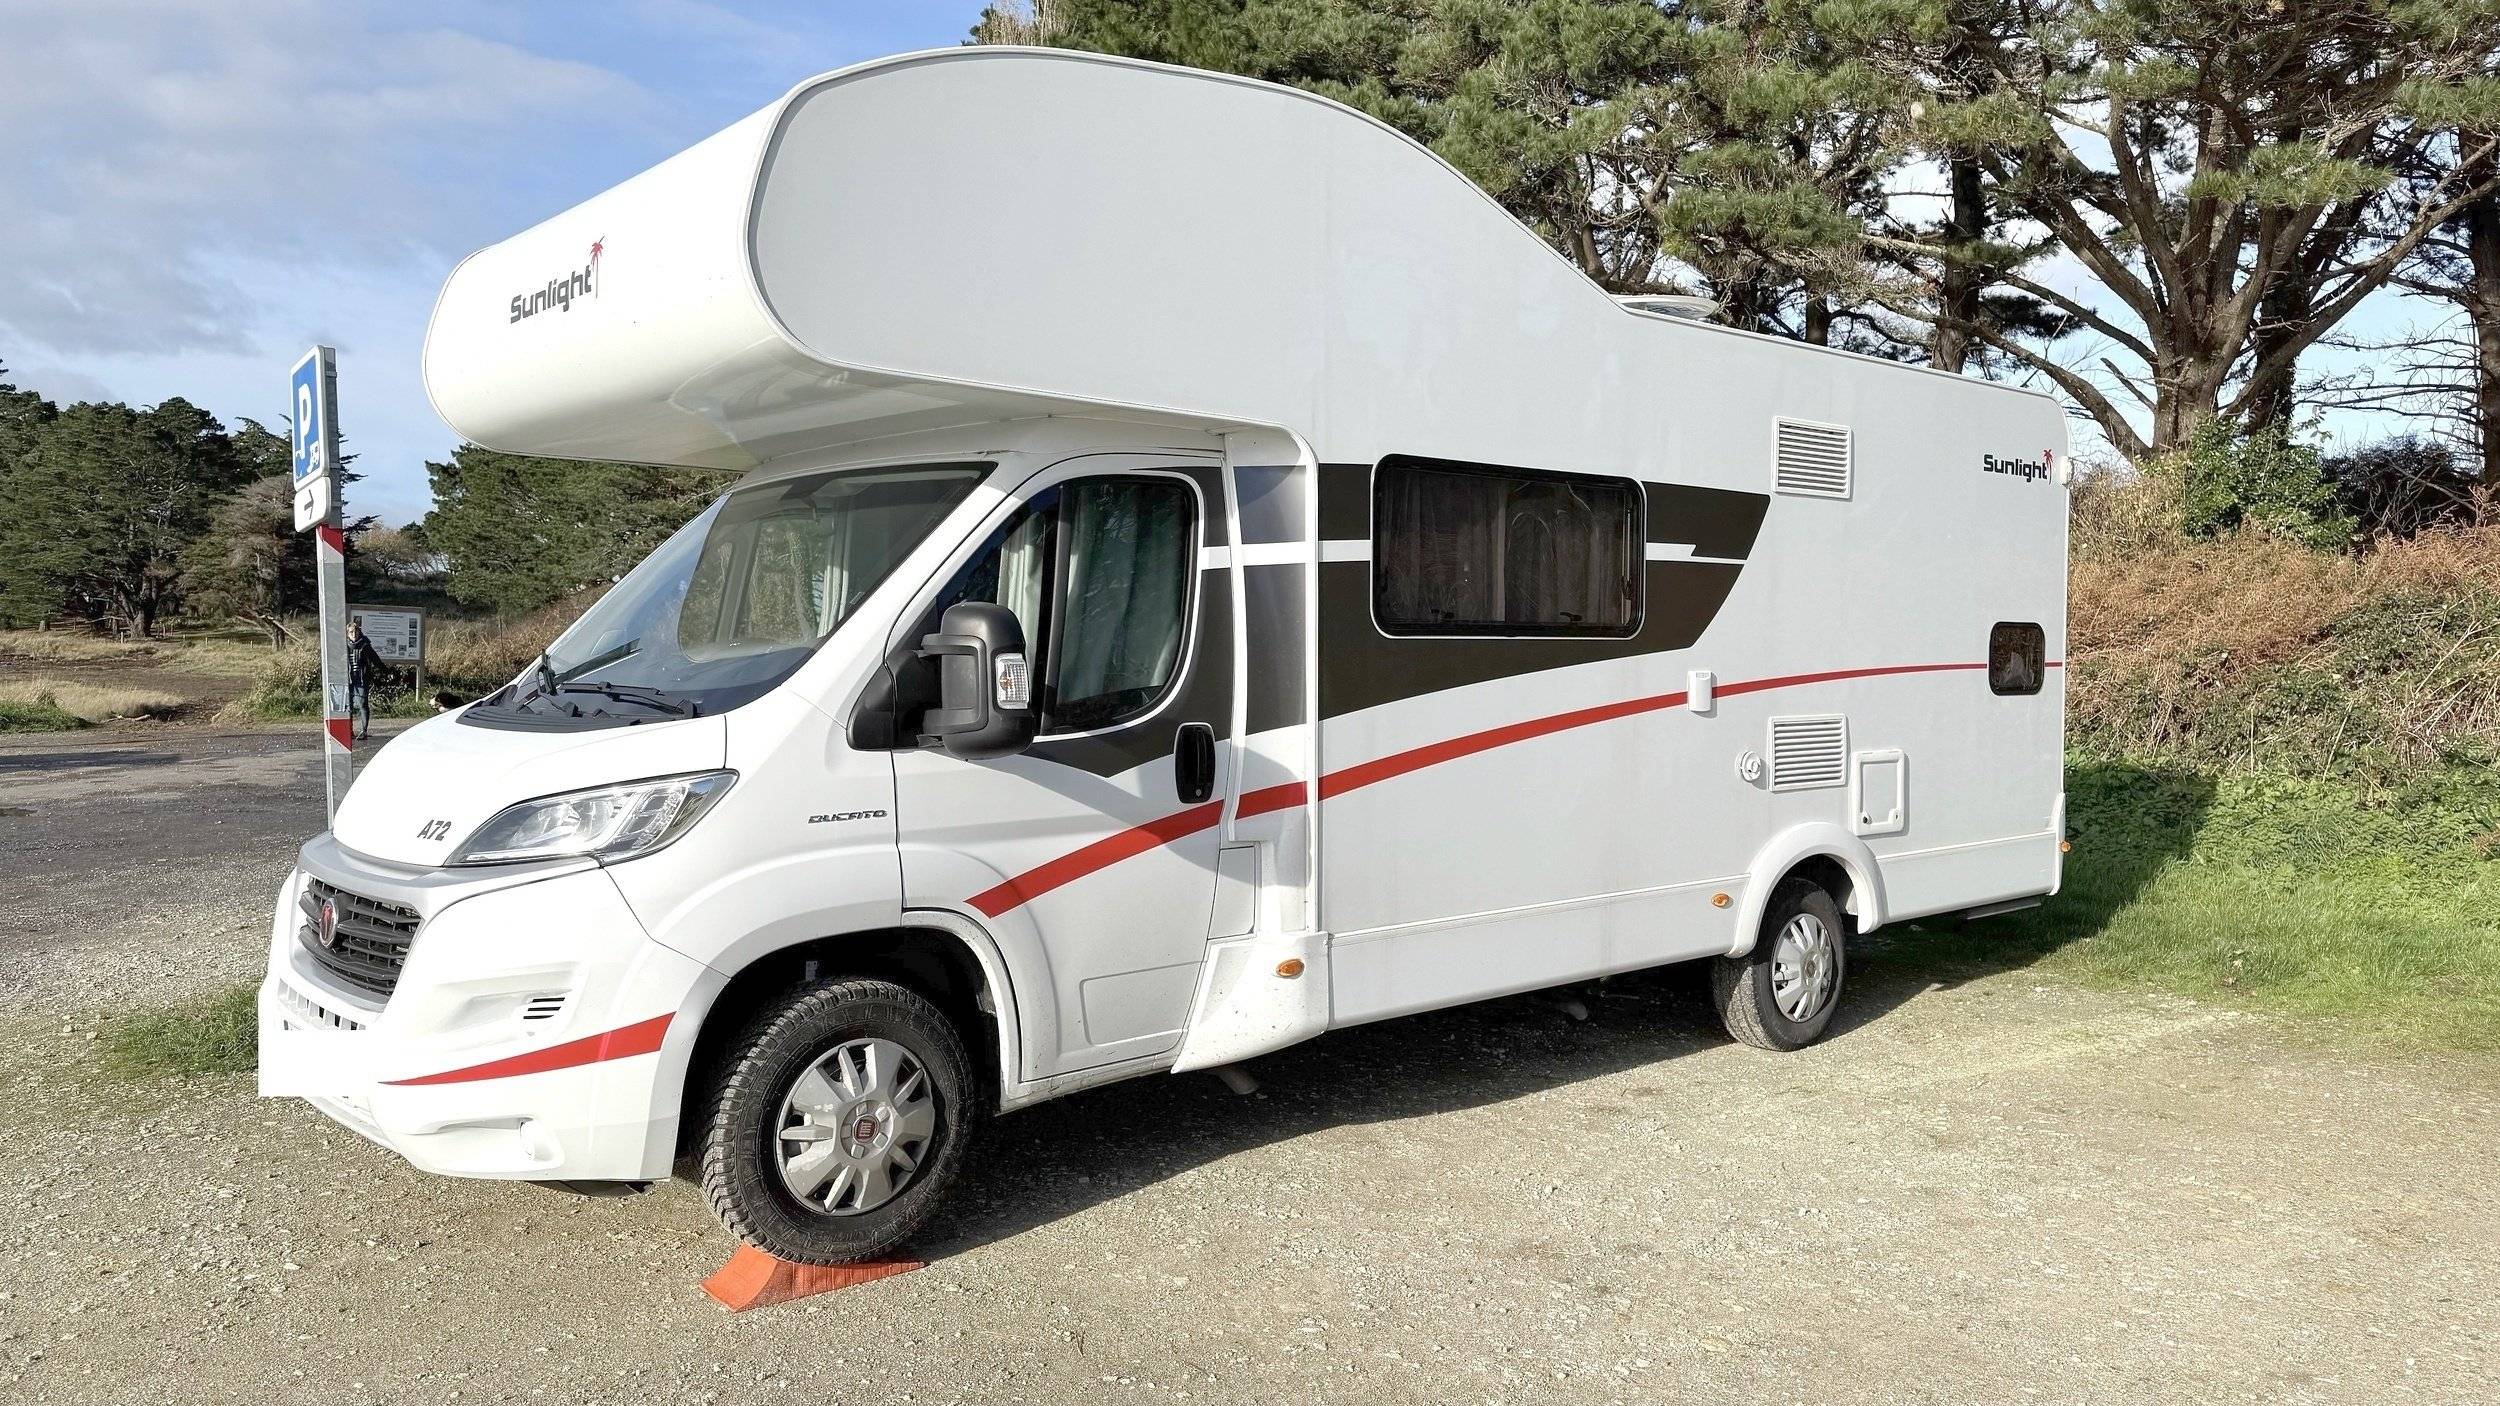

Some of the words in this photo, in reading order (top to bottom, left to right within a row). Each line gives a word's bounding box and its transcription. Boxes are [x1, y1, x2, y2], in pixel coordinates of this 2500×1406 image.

[511, 265, 591, 324] Sunlight
[299, 383, 312, 460] P
[1984, 454, 2047, 482] Sunlight
[417, 820, 452, 841] A72
[808, 810, 888, 824] DUCATO
